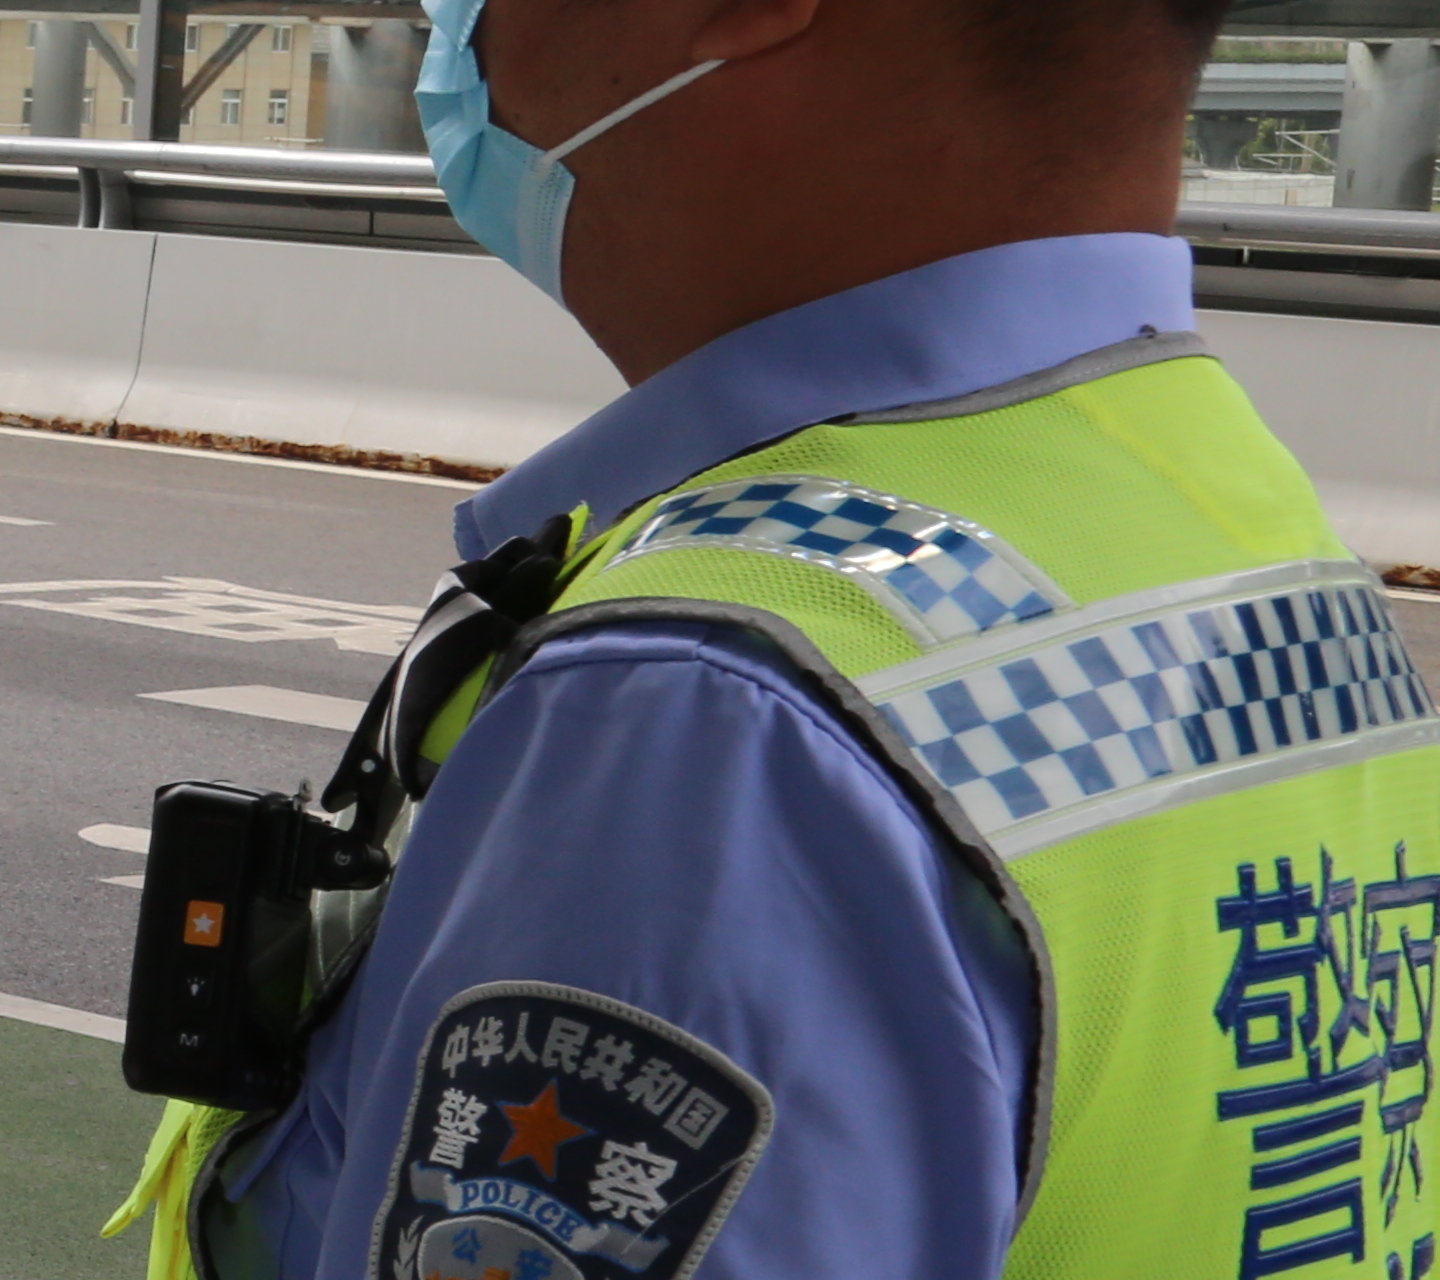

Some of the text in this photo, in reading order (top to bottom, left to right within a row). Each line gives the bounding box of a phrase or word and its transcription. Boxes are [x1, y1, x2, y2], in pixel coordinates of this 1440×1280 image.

[179, 1033, 199, 1048] M
[440, 1011, 730, 1151] 中华人民共和国
[458, 1177, 587, 1241] POLICE
